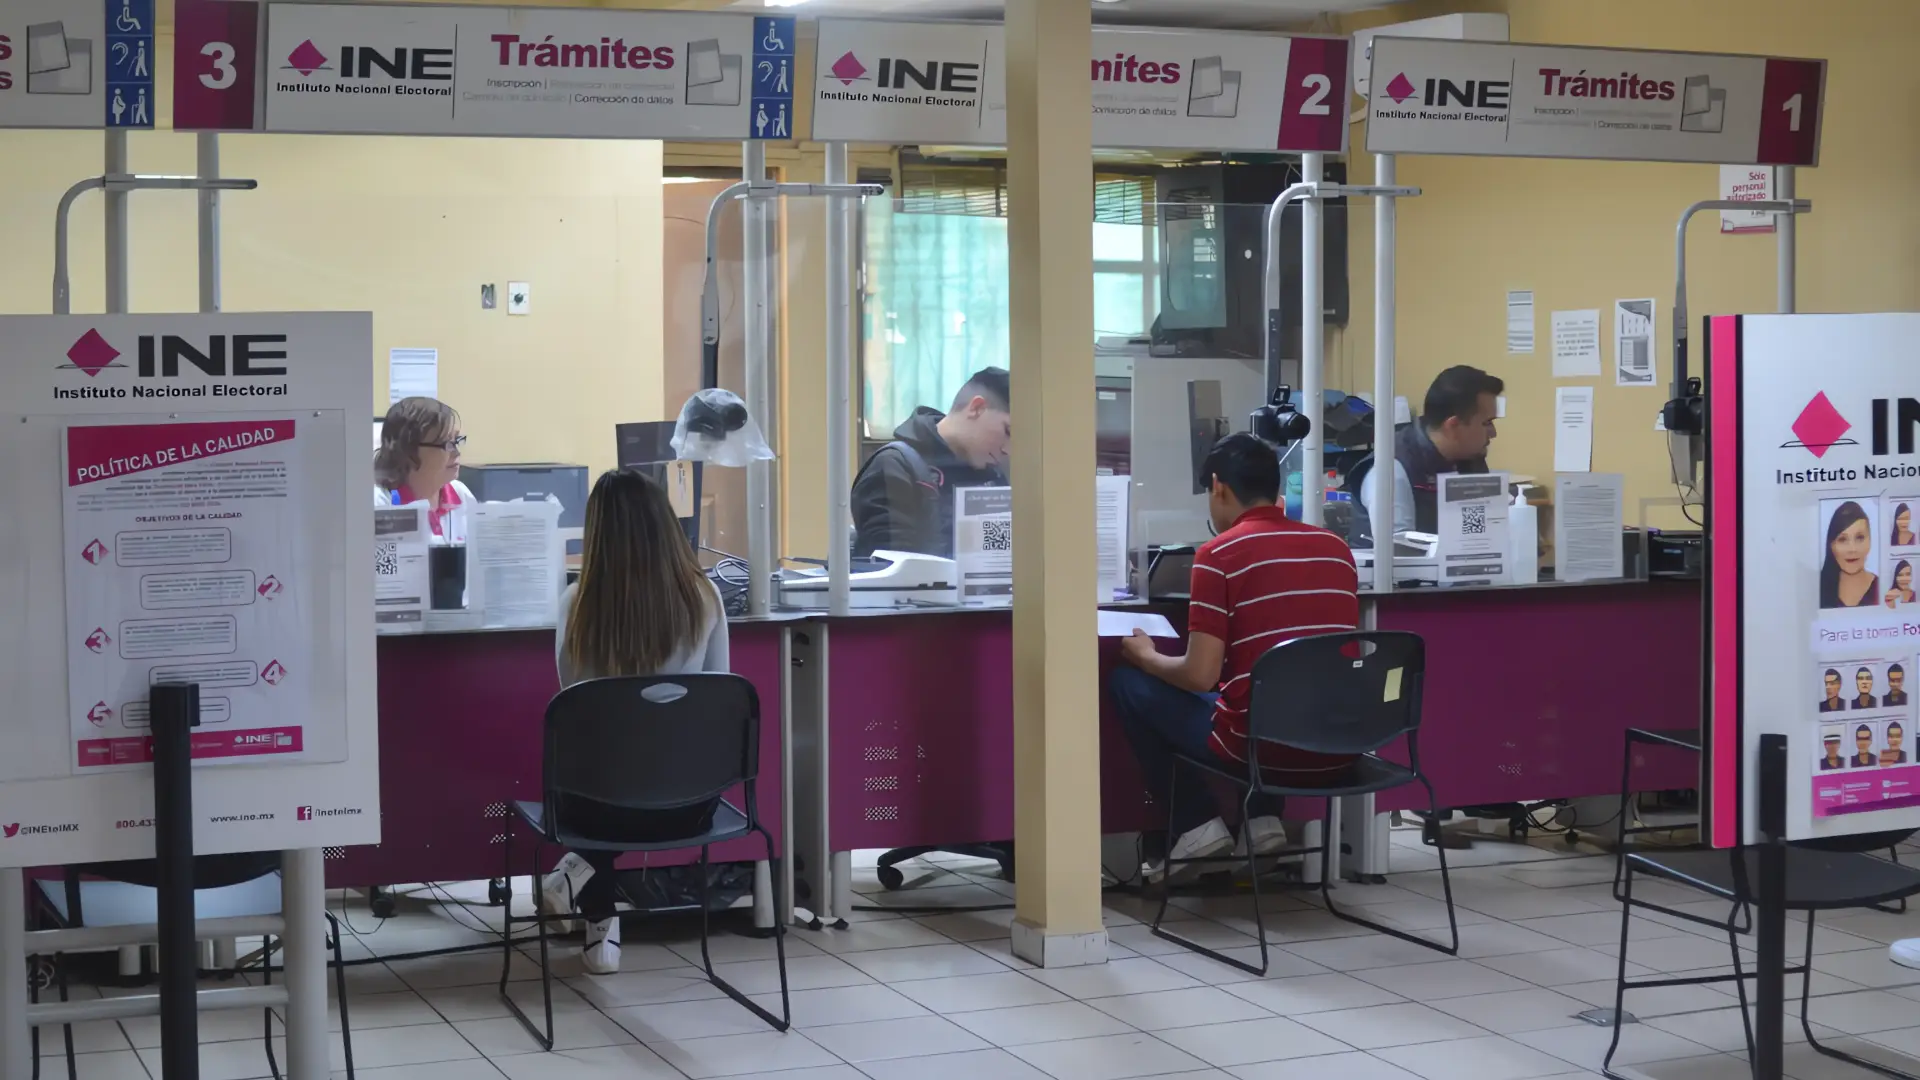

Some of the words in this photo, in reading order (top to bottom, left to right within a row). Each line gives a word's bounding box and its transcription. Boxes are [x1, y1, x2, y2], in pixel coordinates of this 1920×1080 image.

[199, 41, 237, 90] 3
[340, 46, 453, 81] INE
[491, 34, 675, 70] Trámites
[276, 82, 331, 94] Instituto
[335, 83, 391, 95] Nacional
[395, 84, 452, 97] Electoral
[878, 57, 980, 93] INE
[1539, 68, 1675, 100] Trámites
[820, 90, 868, 102] Instituto
[872, 93, 922, 105] Nacional
[925, 96, 976, 108] Electoral
[1299, 73, 1331, 115] 2
[1424, 78, 1510, 109] INE
[1376, 109, 1417, 120] Instituto
[1419, 111, 1462, 121] Nacional
[1464, 111, 1507, 123] Electoral
[1782, 93, 1803, 131] 1
[138, 334, 287, 378] INE
[54, 386, 126, 399] Instituto
[132, 384, 206, 398] Nacional
[213, 383, 288, 397] Electoral
[77, 452, 153, 482] POLÍTICA
[156, 448, 178, 464] DE
[181, 444, 202, 460] LA
[205, 427, 276, 454] CALIDAD
[1776, 467, 1857, 484] Instituto
[1864, 462, 1920, 479] Nacio
[262, 576, 281, 598] 2
[1820, 628, 1848, 642] Para
[1853, 627, 1863, 640] la
[1866, 626, 1899, 639] toma
[245, 734, 272, 744] INE
